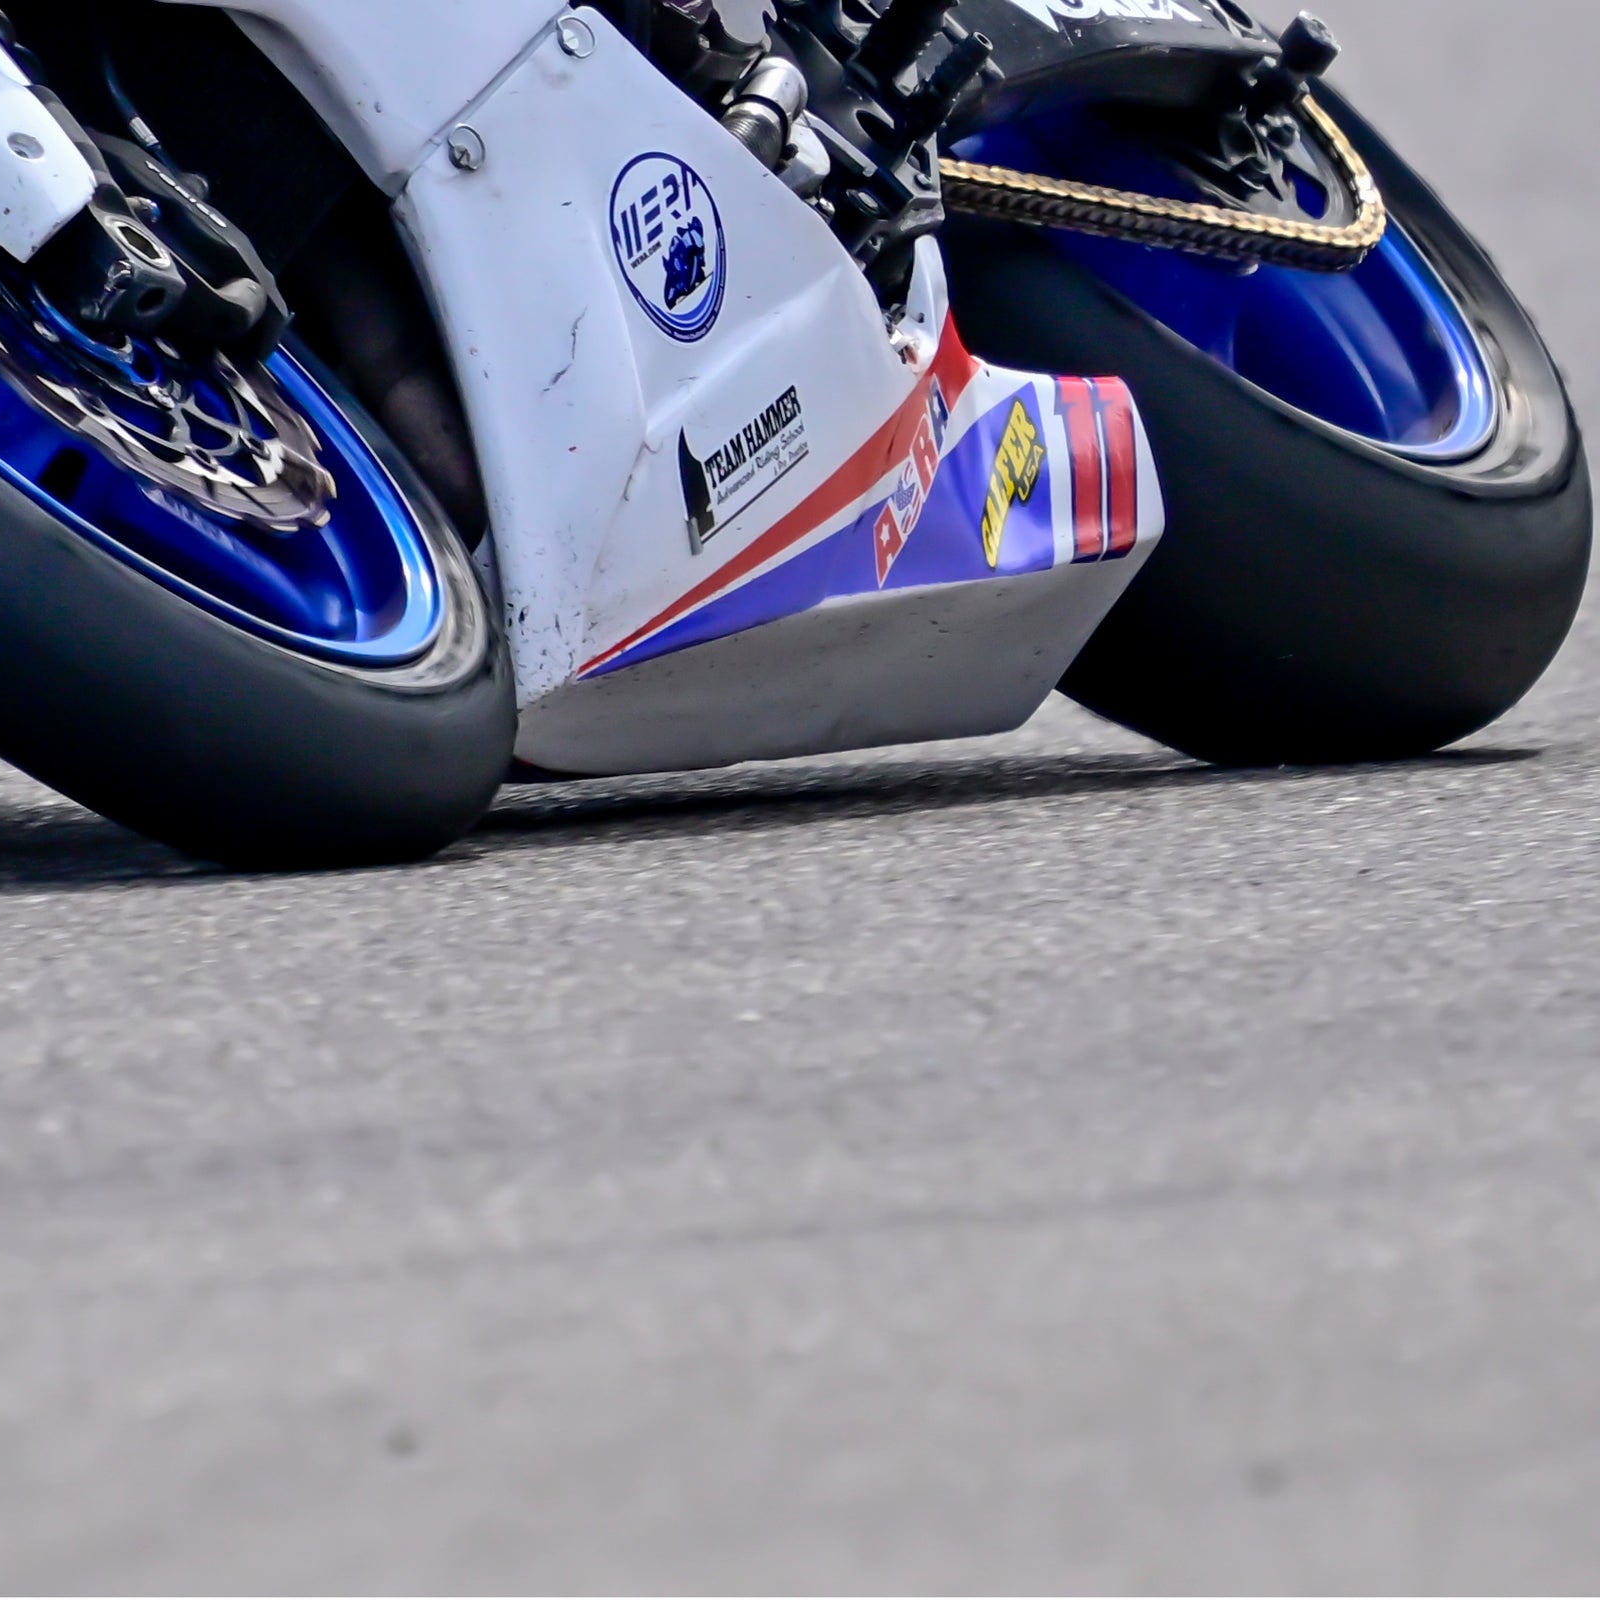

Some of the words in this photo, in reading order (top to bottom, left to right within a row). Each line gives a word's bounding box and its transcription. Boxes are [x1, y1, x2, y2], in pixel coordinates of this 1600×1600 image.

[702, 432, 747, 489] TEAM
[740, 384, 801, 458] HAMMER
[716, 461, 755, 505] Advanced
[753, 441, 780, 470] Riding
[780, 418, 805, 450] School
[873, 372, 951, 589] ASRA
[981, 399, 1037, 568] GALFER
[1015, 445, 1044, 501] USA
